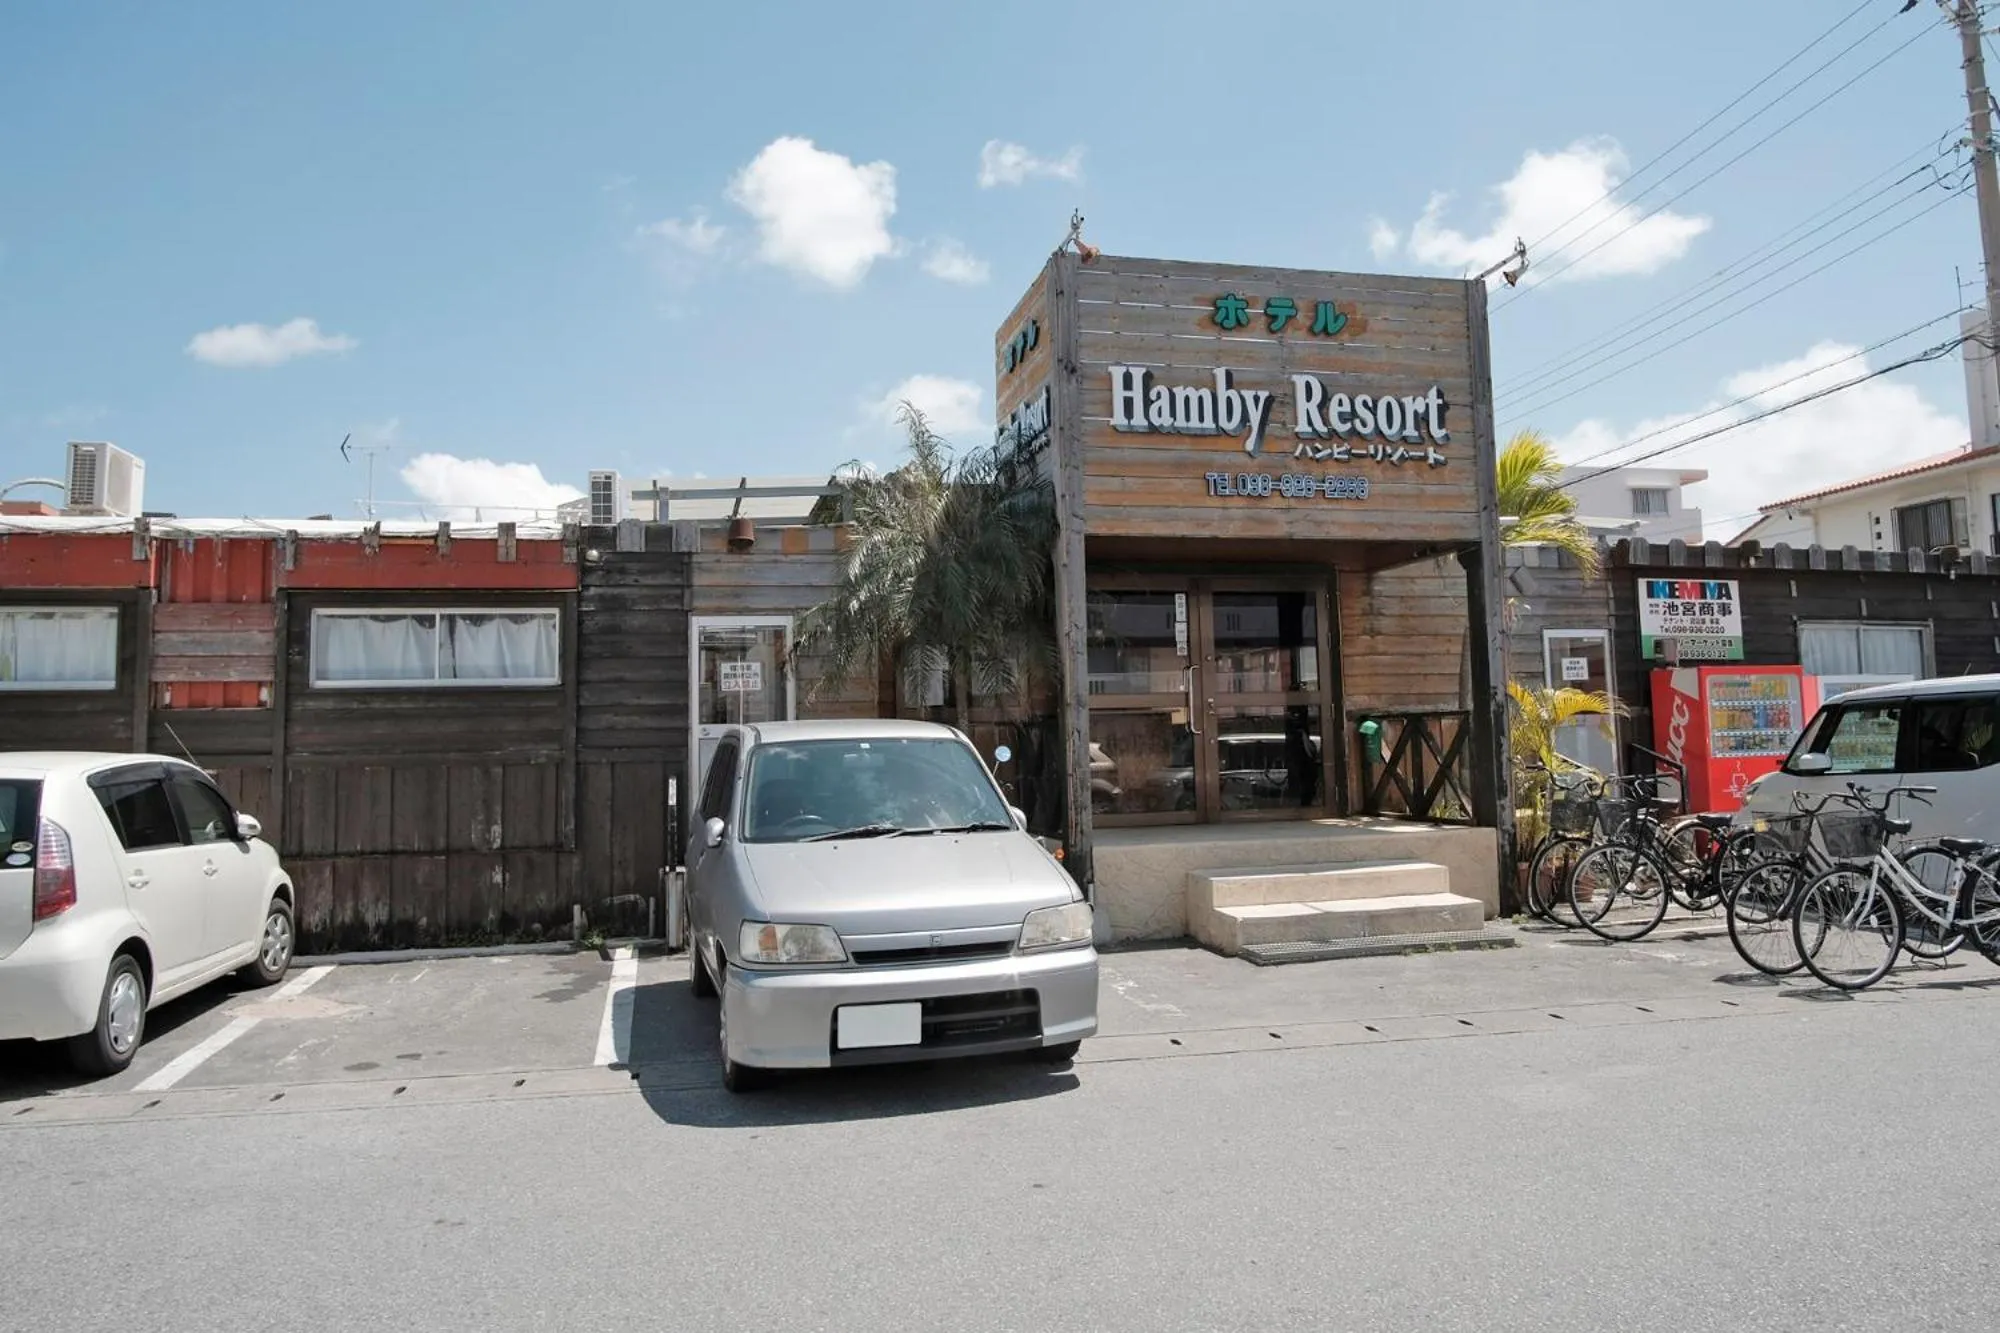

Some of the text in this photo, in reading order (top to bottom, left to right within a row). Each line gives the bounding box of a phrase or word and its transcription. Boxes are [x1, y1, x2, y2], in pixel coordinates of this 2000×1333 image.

[1213, 292, 1348, 337] ホテル
[1108, 365, 1272, 455] Hamby
[1291, 374, 1450, 443] Resort
